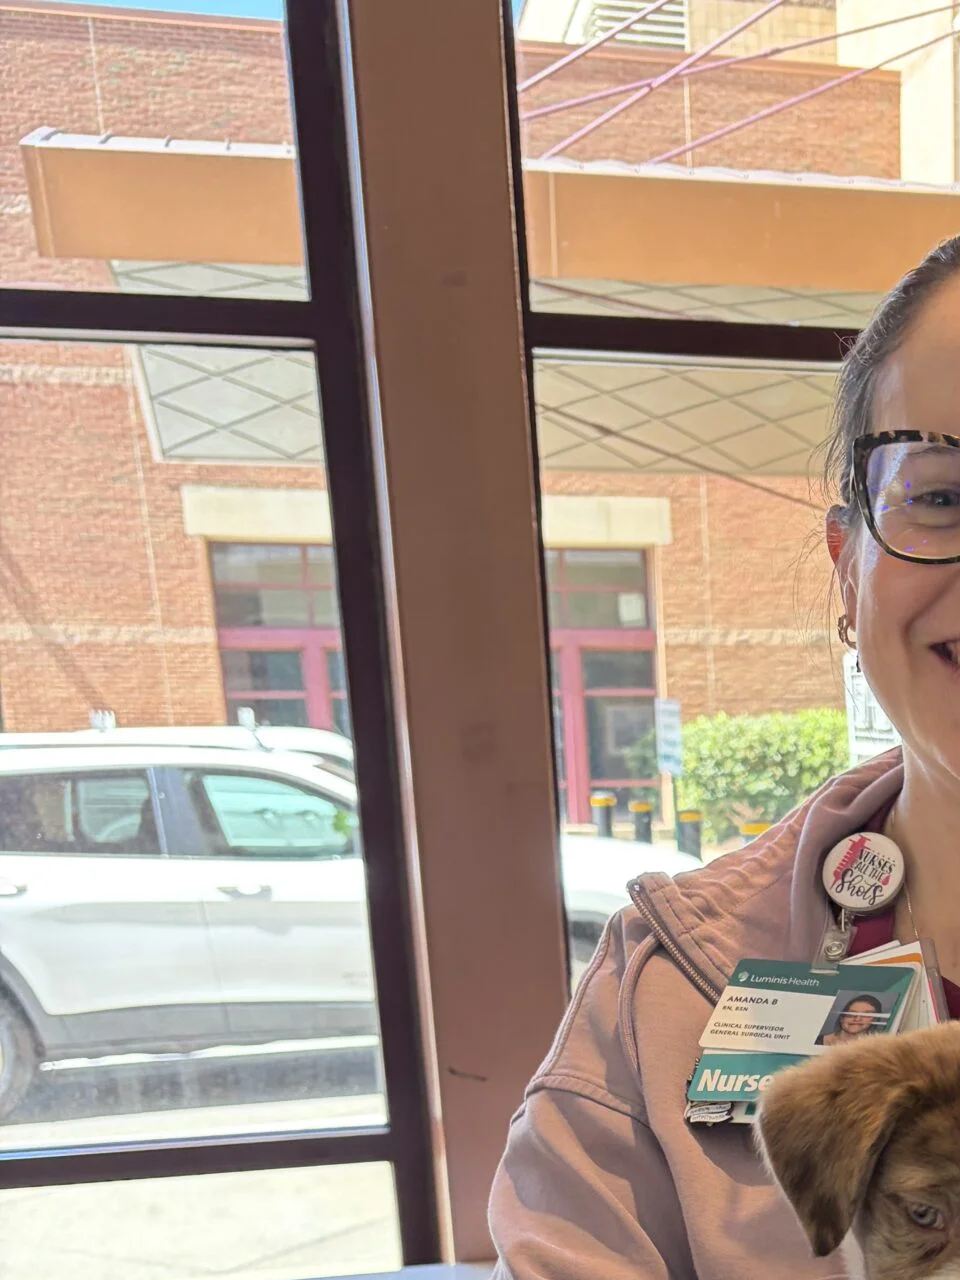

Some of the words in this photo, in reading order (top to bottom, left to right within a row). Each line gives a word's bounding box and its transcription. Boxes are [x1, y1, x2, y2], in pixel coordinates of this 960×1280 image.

[859, 849, 895, 874] NURSES
[868, 867, 883, 882] THE
[836, 868, 884, 905] Shots
[750, 974, 787, 985] Luminis
[788, 976, 820, 987] Health
[727, 996, 769, 1005] AMANDA
[741, 1031, 772, 1039] SURGICAL
[744, 1024, 784, 1032] SUPERVISOR
[697, 1068, 772, 1092] Nurse
